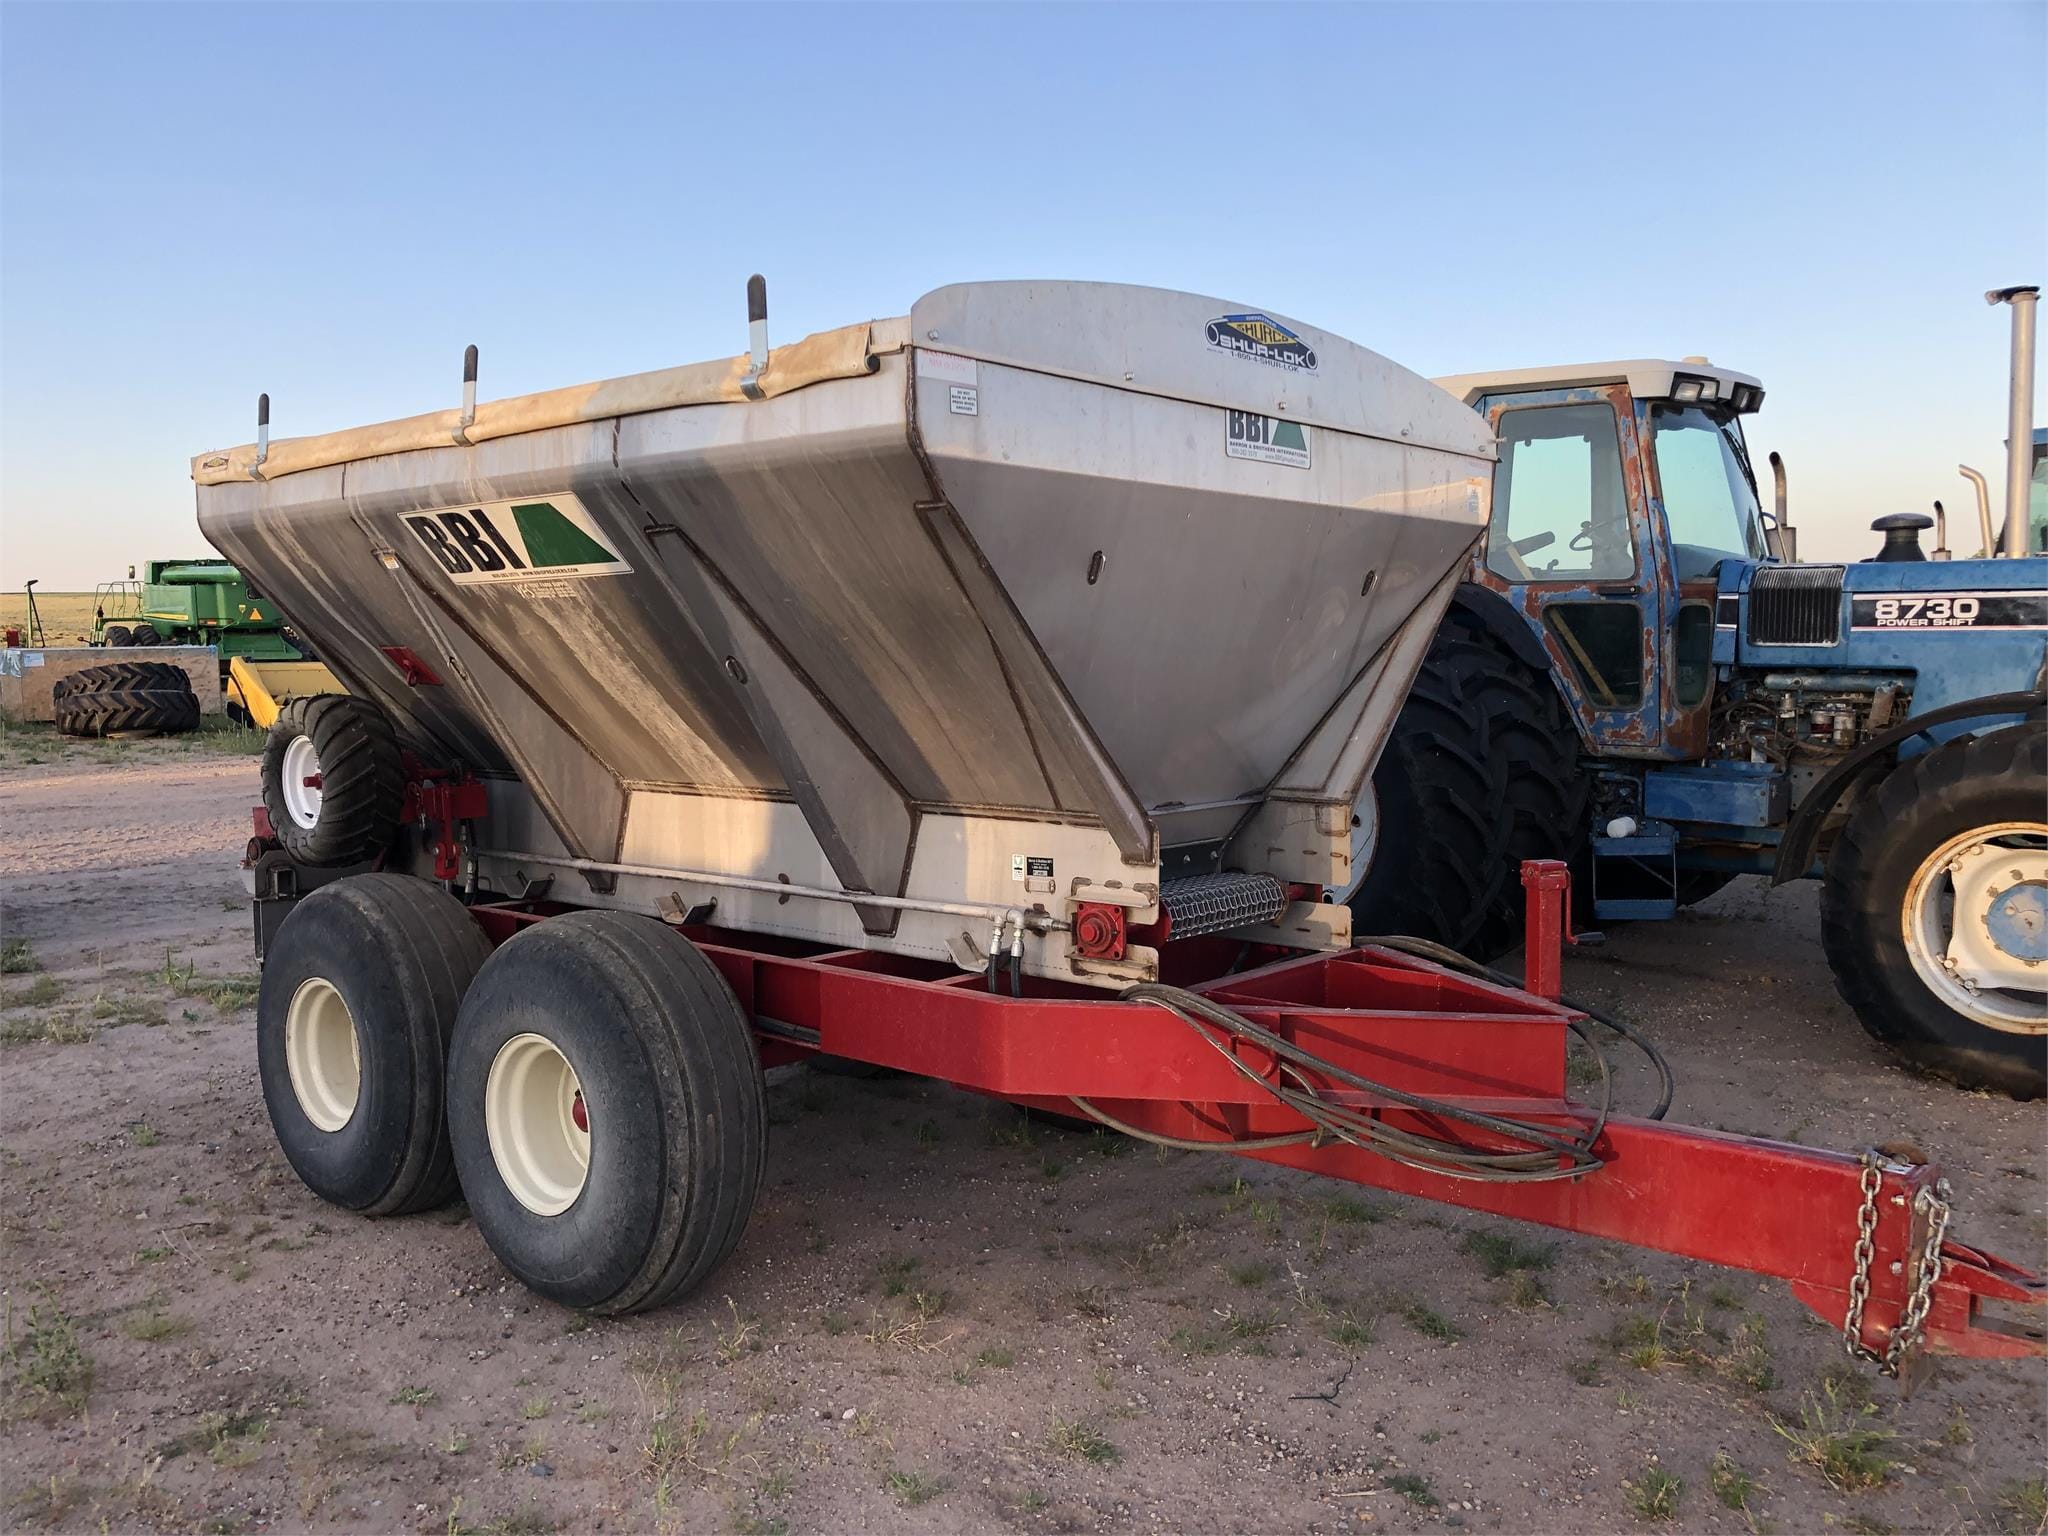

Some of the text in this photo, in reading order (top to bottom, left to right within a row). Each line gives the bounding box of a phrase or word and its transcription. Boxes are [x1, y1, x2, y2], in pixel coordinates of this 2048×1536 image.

[1236, 322, 1289, 344] SHURCO
[1220, 335, 1307, 368] SHUR-LOK
[1229, 409, 1269, 445] BBI
[405, 509, 527, 573] BBI
[1875, 598, 1980, 619] 8730
[1877, 618, 1976, 626] POWER SHIFT
